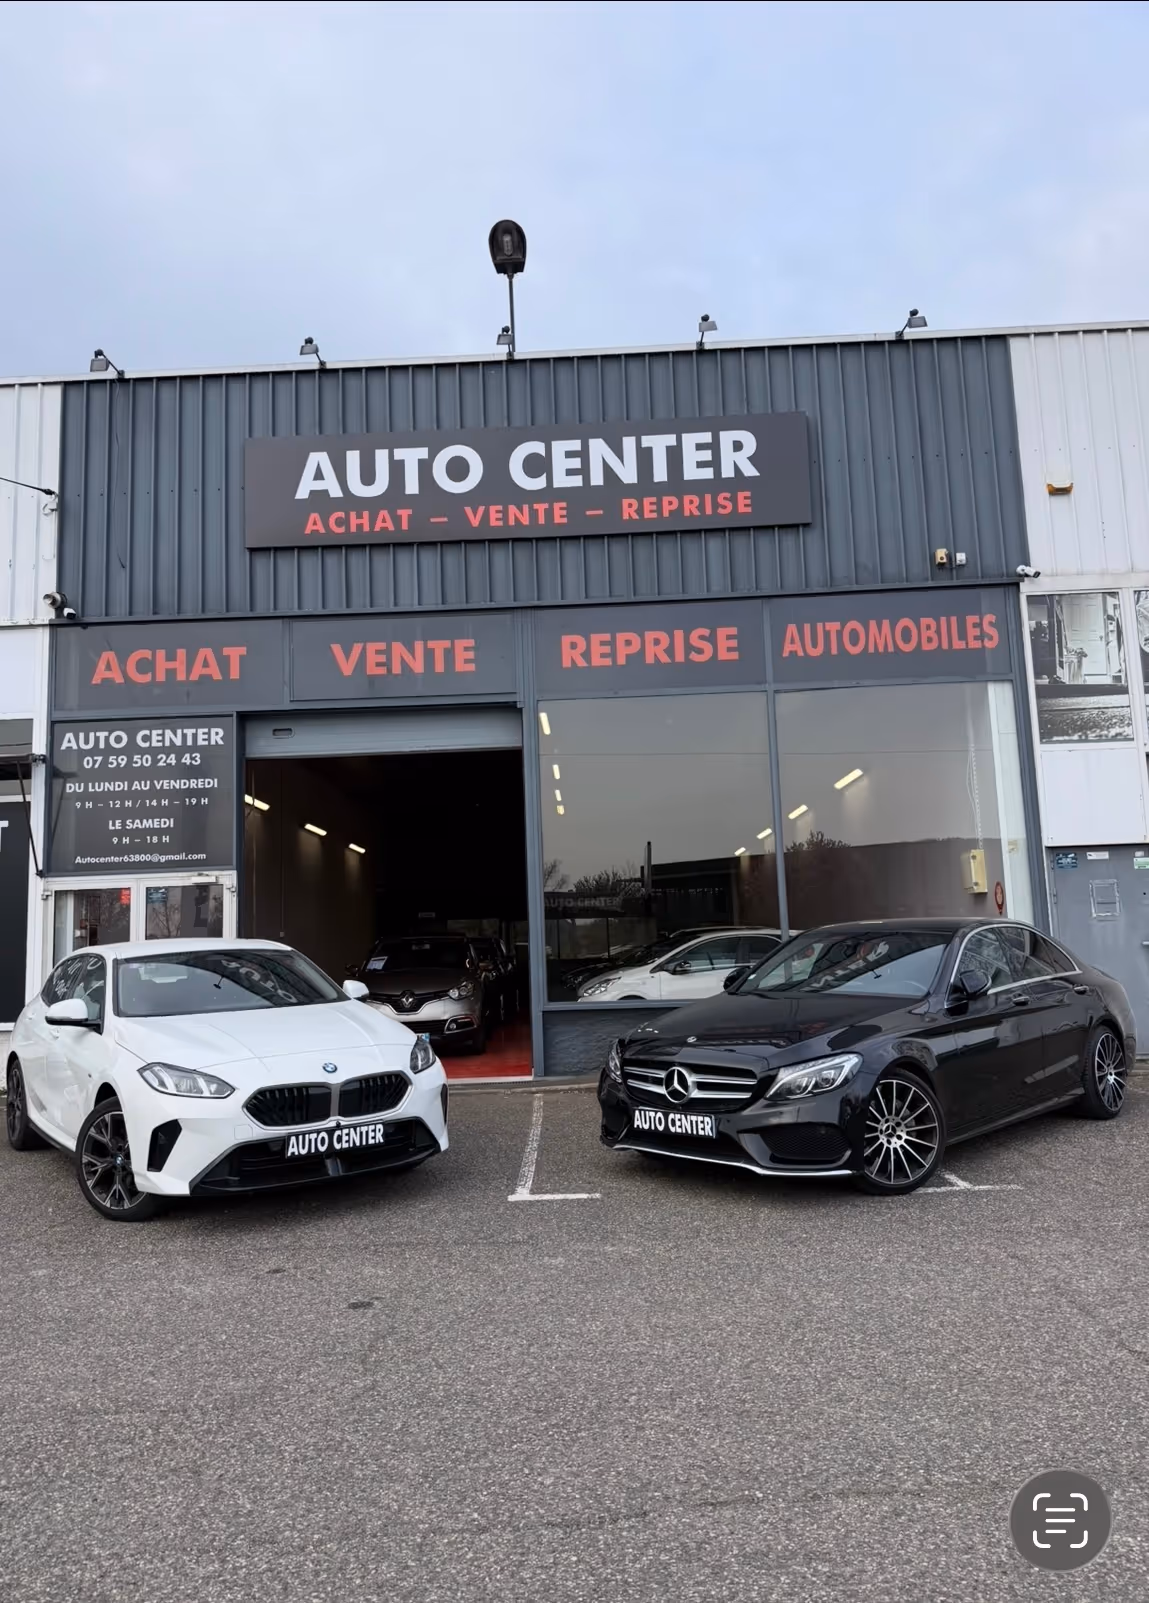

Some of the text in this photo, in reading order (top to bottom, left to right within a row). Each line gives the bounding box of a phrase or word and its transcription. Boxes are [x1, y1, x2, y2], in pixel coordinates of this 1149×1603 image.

[294, 429, 761, 500] AUTO CENTER
[304, 508, 412, 535] ACHAT
[463, 501, 568, 528] VENTE
[621, 491, 752, 520] REPRISE
[560, 627, 739, 668] REPRISE
[782, 613, 1000, 657] AUTOMOBILES
[91, 646, 247, 685] ACHAT
[330, 638, 476, 676] VENTE
[60, 727, 225, 750] AUTO CENTER
[83, 753, 201, 769] 07 59 50 24 43
[65, 778, 218, 793] DU LUNDI AU VENDREDI
[75, 801, 82, 809] 9
[85, 801, 93, 809] H
[109, 800, 121, 808] 12
[145, 799, 157, 807] 14
[161, 799, 169, 807] H
[185, 798, 197, 806] 19
[201, 797, 209, 805] H
[108, 818, 174, 830] LE SAMEDI
[112, 836, 119, 845] 9
[122, 836, 130, 844] H
[146, 836, 159, 844] 18
[162, 835, 170, 843] H
[74, 852, 207, 865] Autocenter63800@gmail.com
[634, 1110, 713, 1137] AUTO CENTER
[287, 1123, 385, 1157] AUTO CENTER
